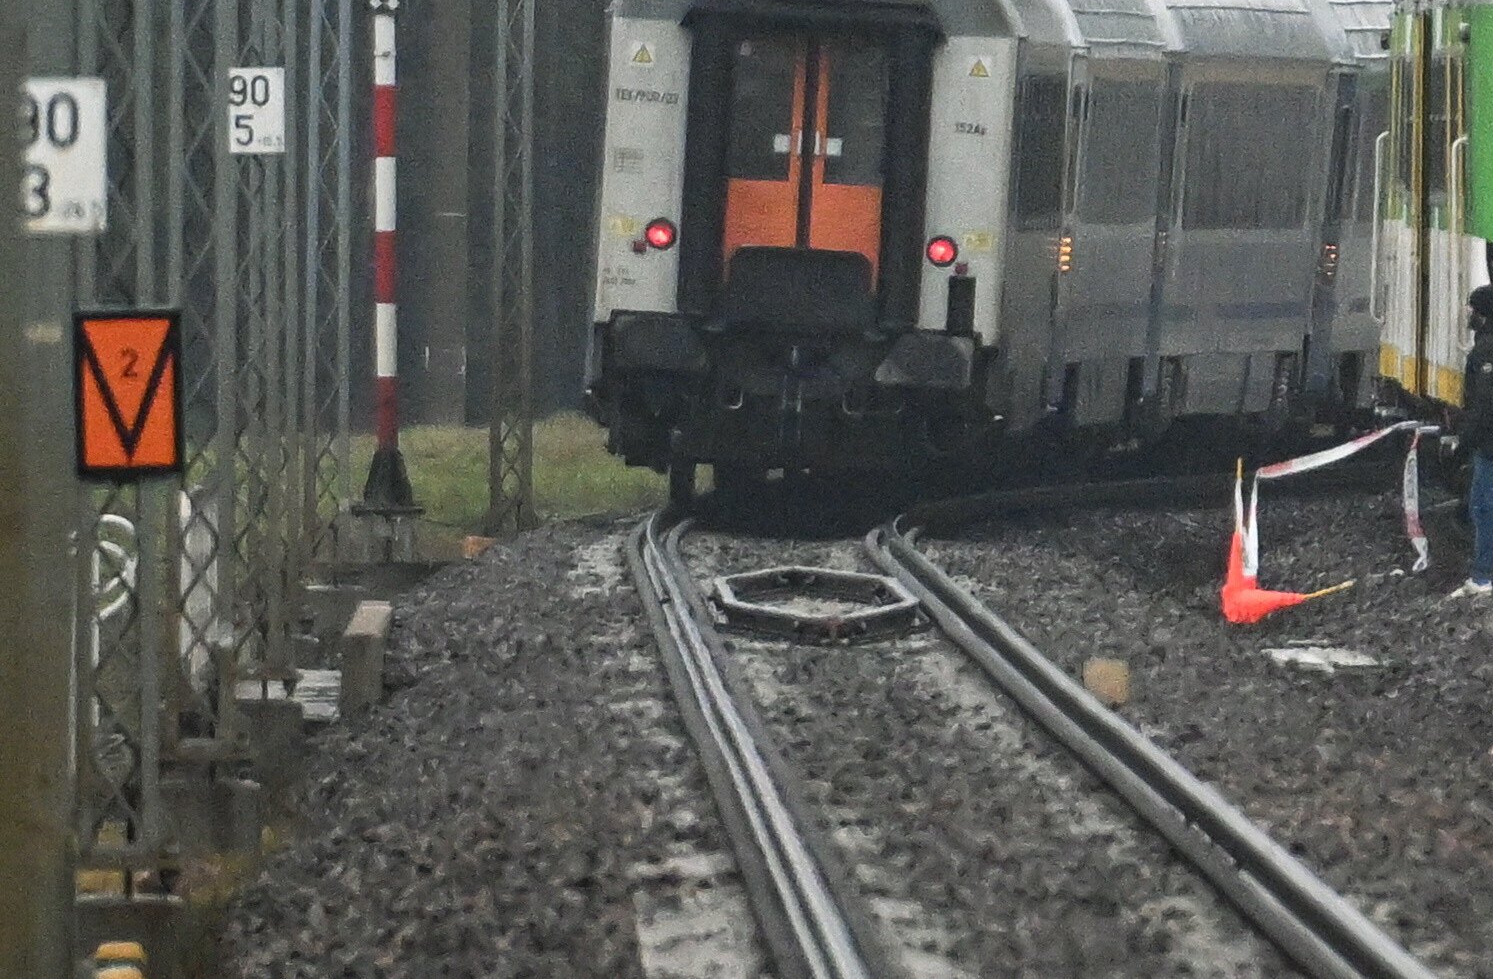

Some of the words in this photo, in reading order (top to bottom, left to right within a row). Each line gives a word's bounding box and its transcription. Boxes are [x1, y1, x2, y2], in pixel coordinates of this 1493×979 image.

[229, 75, 269, 107] 90
[235, 115, 254, 146] 5
[120, 346, 139, 379] 2
